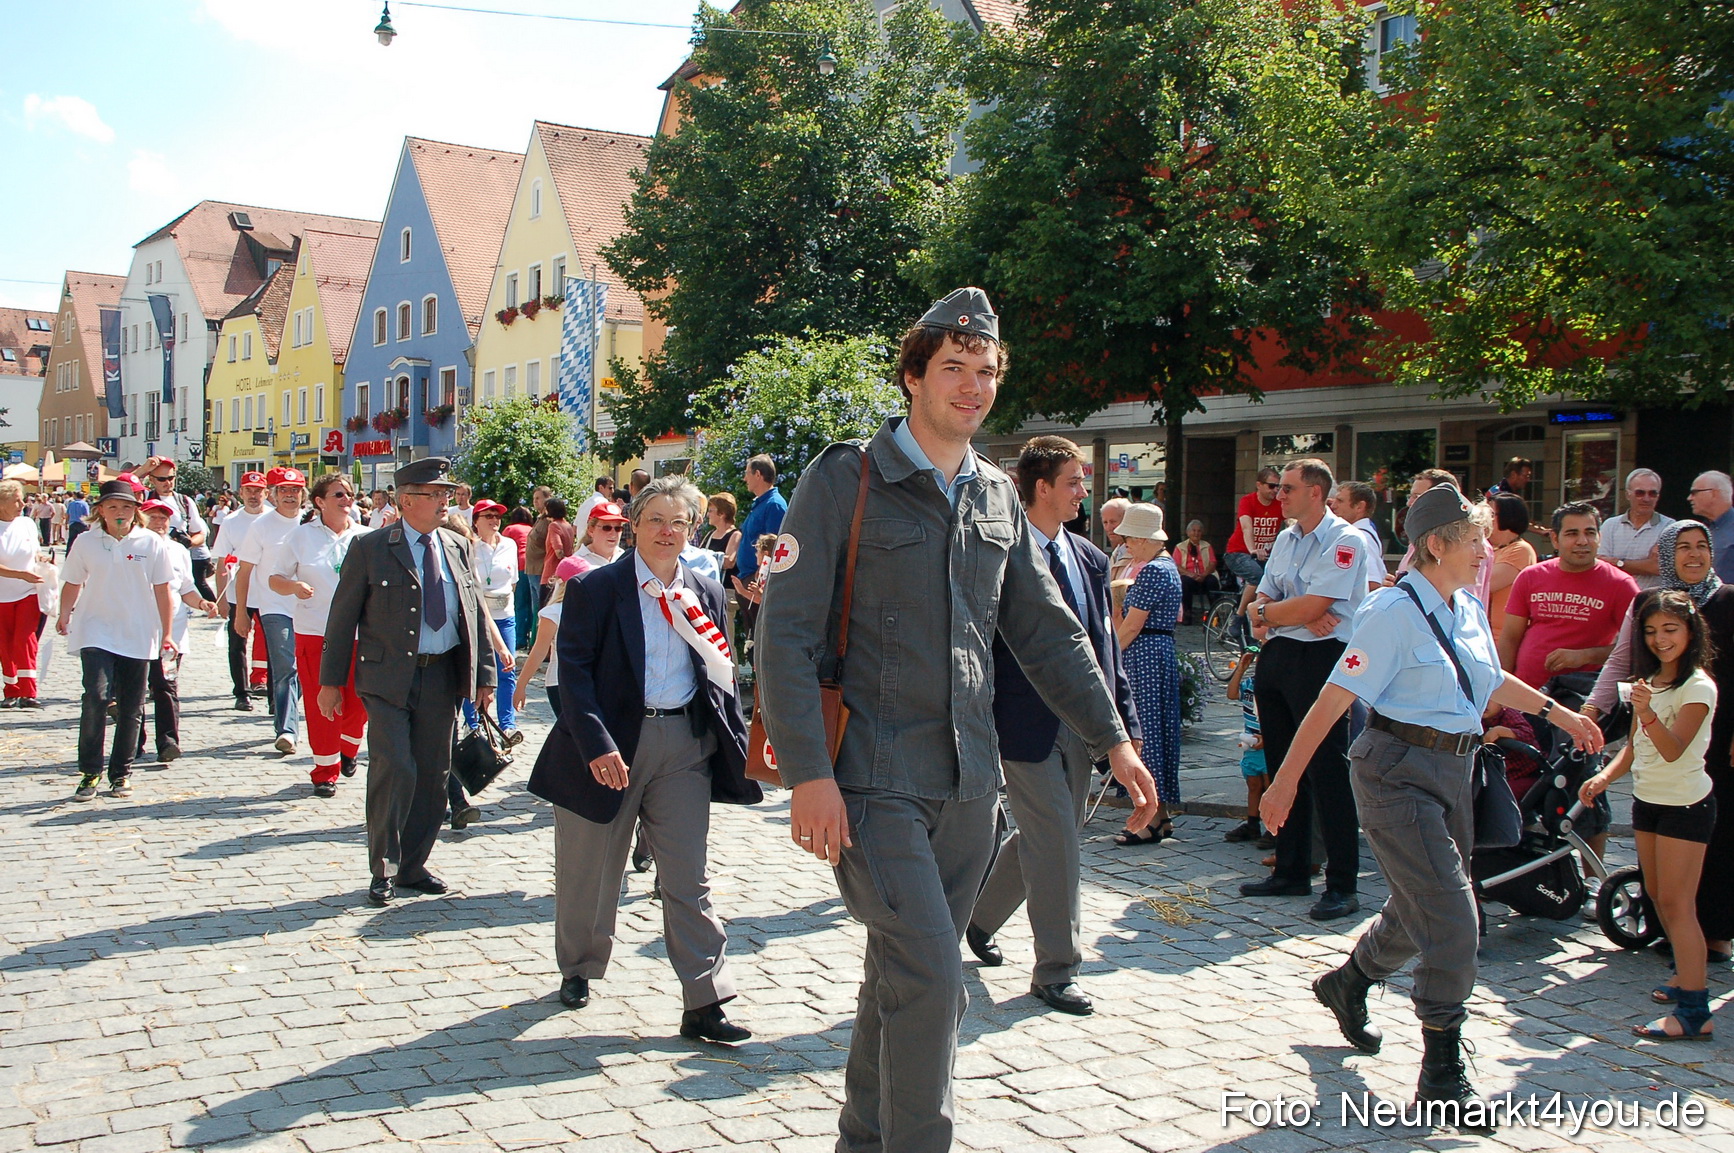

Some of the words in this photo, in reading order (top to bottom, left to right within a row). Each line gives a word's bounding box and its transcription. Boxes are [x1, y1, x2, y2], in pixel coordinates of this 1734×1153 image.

[236, 377, 252, 392] HOTEL
[233, 446, 255, 457] Restaurant
[1254, 517, 1278, 526] FOOT
[1254, 527, 1276, 536] BALL
[1530, 592, 1564, 602] DENIM
[1564, 593, 1605, 610] BRAND
[1547, 603, 1580, 615] VINTAGE
